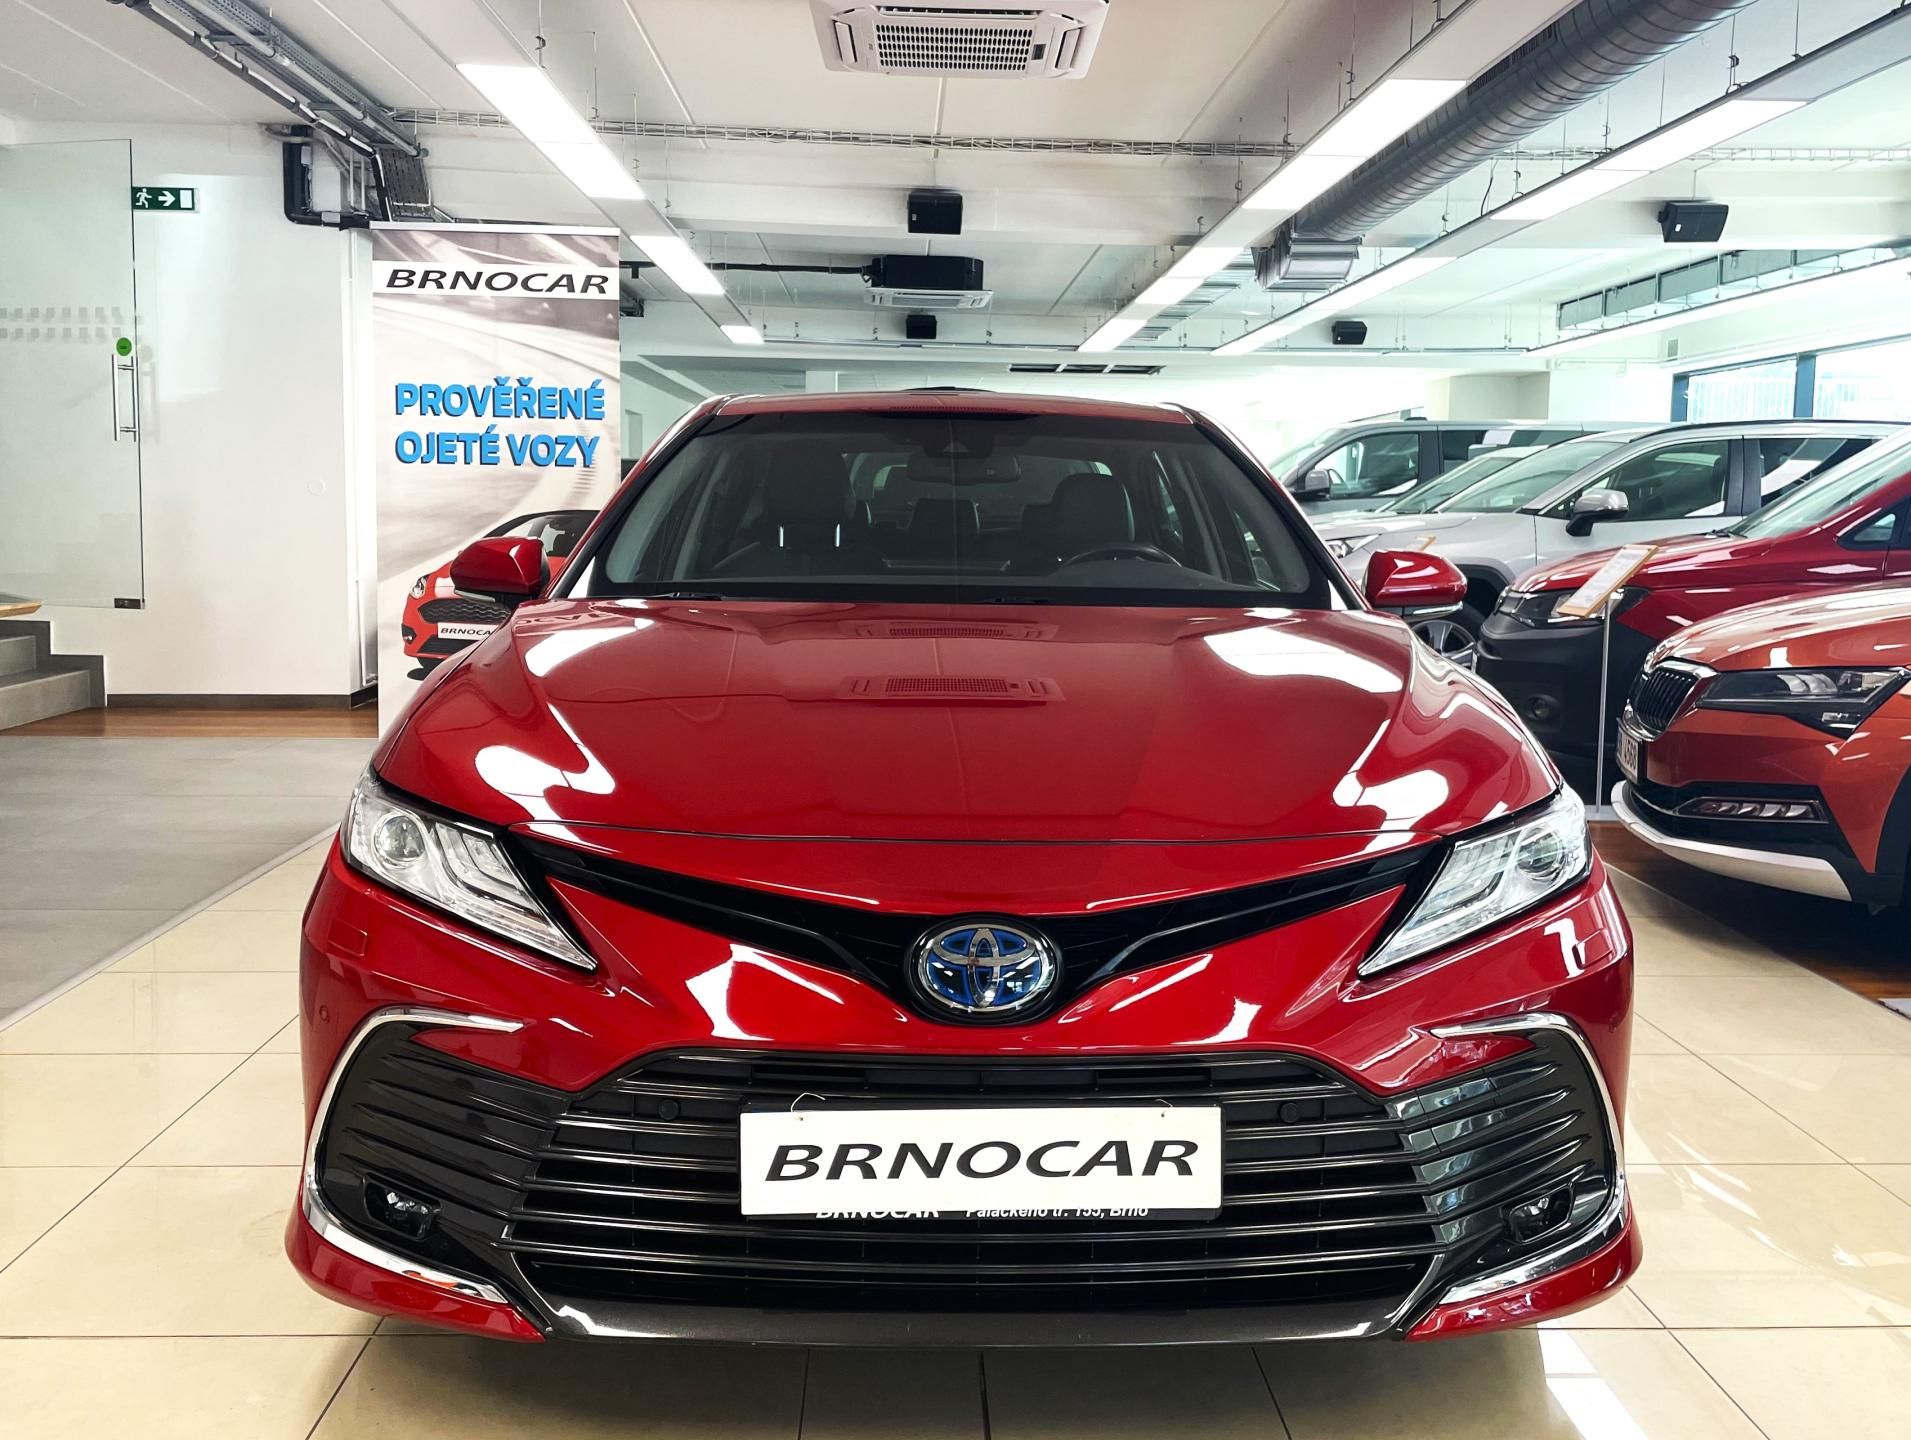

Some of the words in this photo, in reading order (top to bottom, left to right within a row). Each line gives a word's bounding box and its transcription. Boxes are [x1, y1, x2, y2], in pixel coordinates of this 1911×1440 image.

[386, 269, 609, 294] BRNOCAR
[395, 376, 605, 420] PROVĚŘENÉ
[395, 424, 500, 466] OJETÉ
[505, 433, 600, 467] VOZY
[440, 627, 491, 636] BRNOCA
[765, 1140, 1199, 1181] BRNOCAR
[1109, 1206, 1149, 1217] Brno
